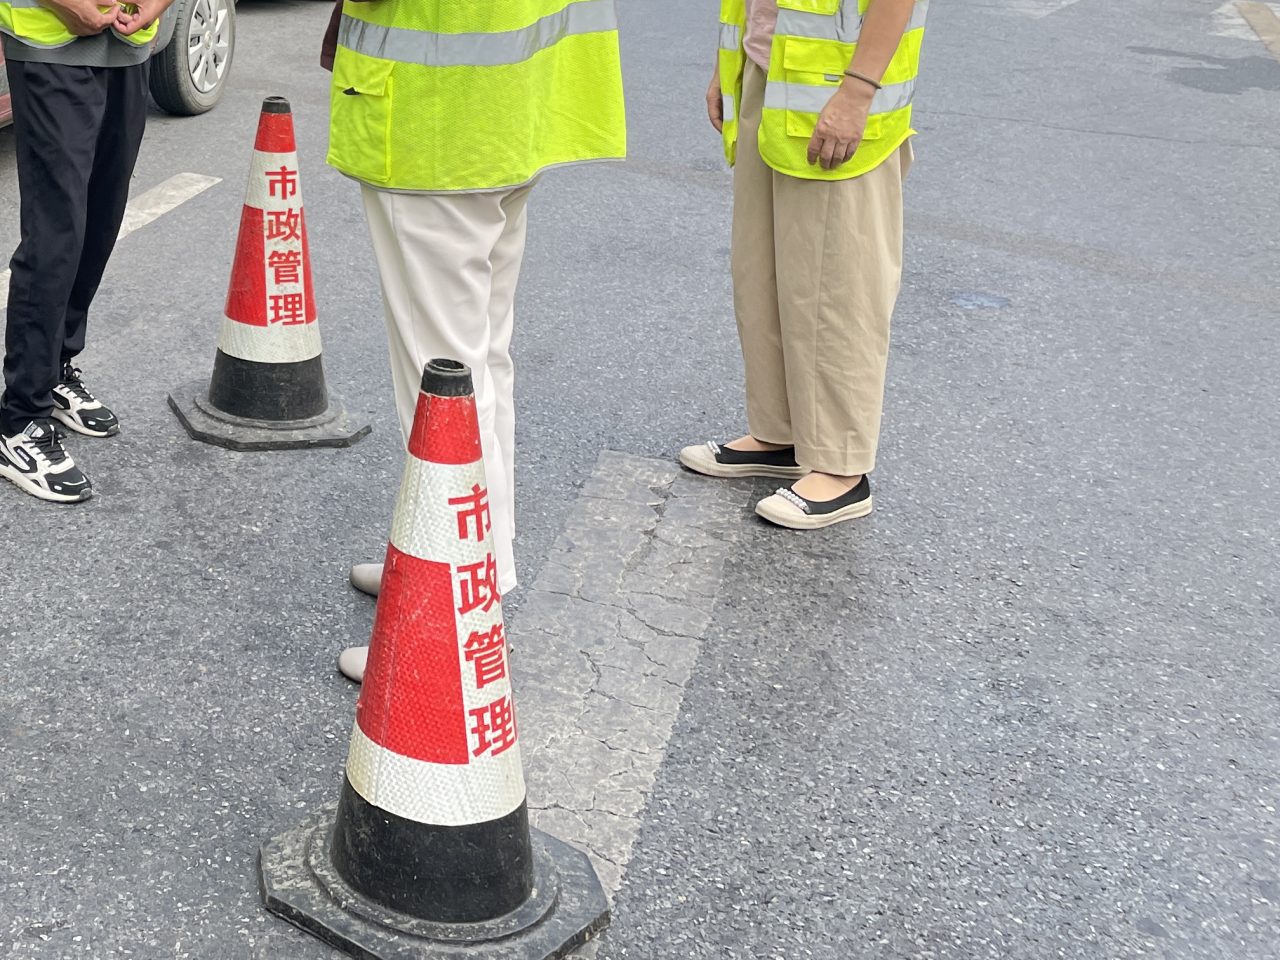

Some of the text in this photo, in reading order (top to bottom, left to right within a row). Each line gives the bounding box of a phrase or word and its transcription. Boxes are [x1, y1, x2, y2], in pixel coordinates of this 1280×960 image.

[264, 165, 306, 327] 市政管理
[448, 482, 516, 758] 市政管理
